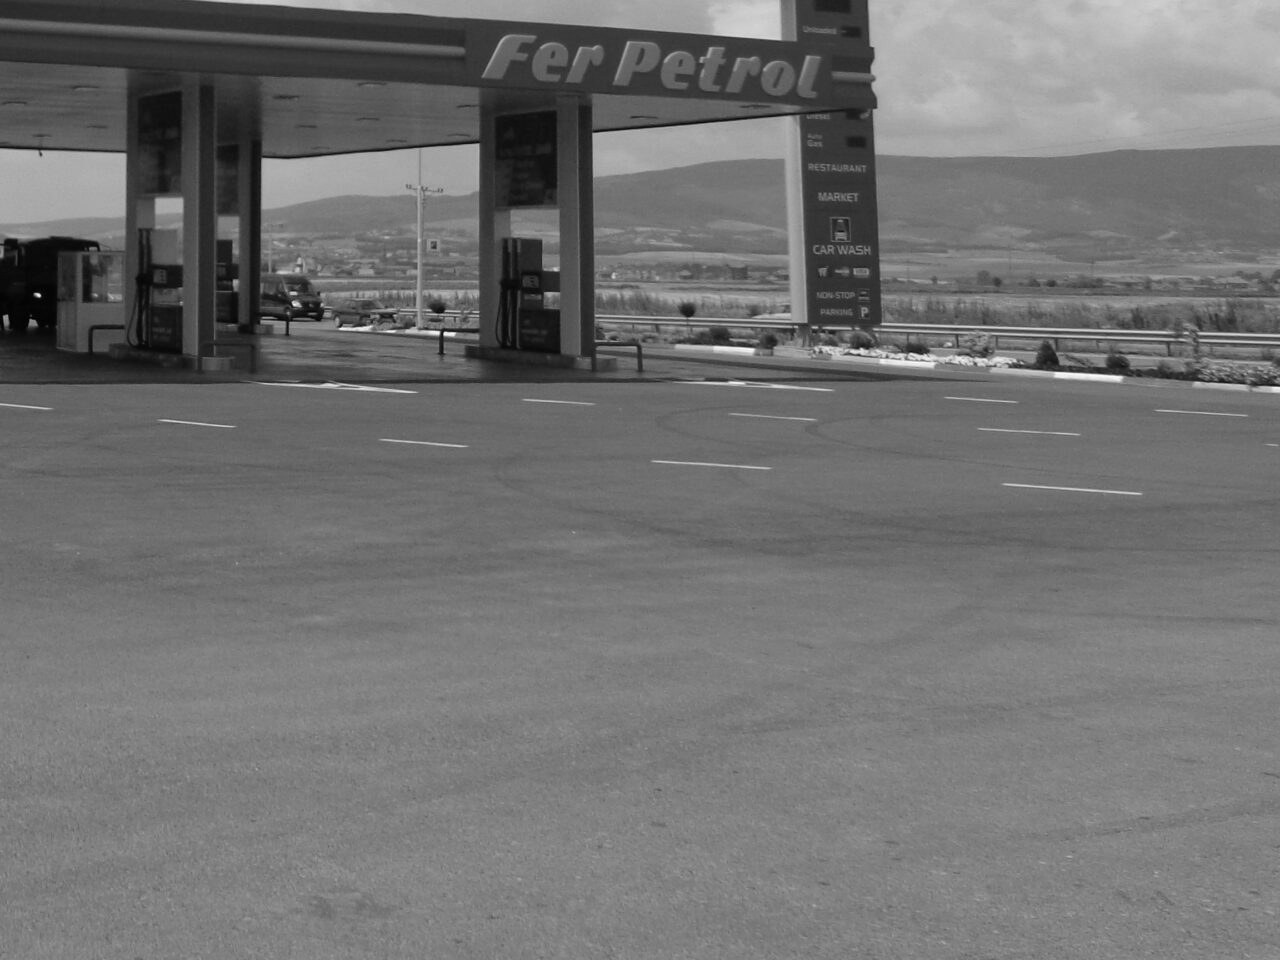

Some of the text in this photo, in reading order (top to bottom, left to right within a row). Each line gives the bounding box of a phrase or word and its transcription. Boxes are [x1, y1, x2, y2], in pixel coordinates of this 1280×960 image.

[481, 34, 822, 99] Fer Petrol
[808, 163, 867, 173] RESTAURANT
[818, 192, 859, 202] MARKET
[813, 245, 871, 255] CAR WASH
[816, 291, 856, 300] NON-STOP
